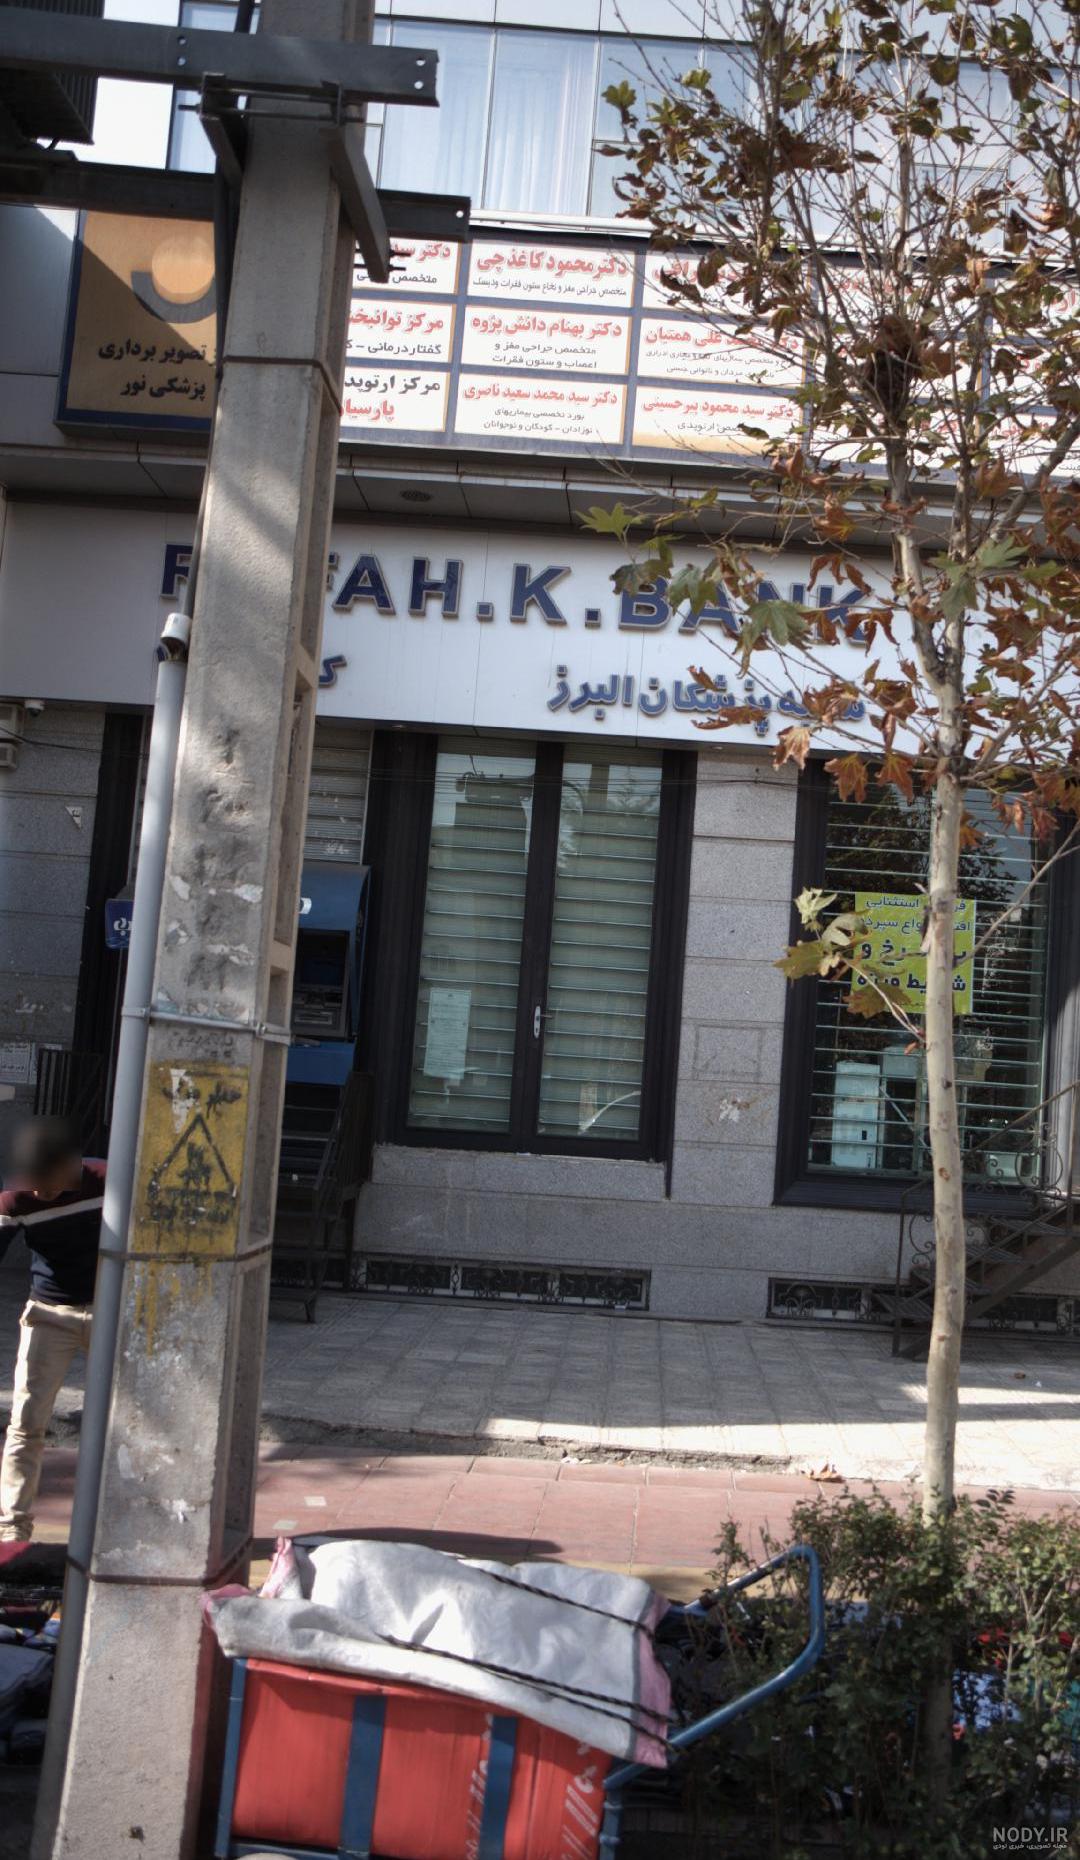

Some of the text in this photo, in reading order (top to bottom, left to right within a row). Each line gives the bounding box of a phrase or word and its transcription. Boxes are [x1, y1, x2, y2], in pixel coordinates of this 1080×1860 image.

[417, 242, 451, 262] دکتر
[546, 252, 593, 276] محمود
[593, 253, 628, 278] دکتر
[392, 273, 438, 285] متخصص
[405, 313, 444, 333] مرکز
[549, 319, 585, 338] بهنام
[588, 321, 623, 340] دکتر
[646, 326, 692, 345] همتیان
[98, 338, 157, 361] برداری
[158, 344, 207, 364] تصویر
[503, 341, 520, 351] مغز
[521, 342, 553, 354] جراحی
[555, 346, 597, 355] متخصص
[492, 355, 524, 365] فقرات
[525, 356, 554, 367] ستون
[564, 358, 598, 369] اعصاب
[120, 374, 206, 401] پزشکی نور
[345, 375, 441, 395] مرکز ارتوپد
[464, 383, 618, 407] دکتر سید محمد سعید ناصری
[339, 399, 395, 421] پارسیا
[702, 402, 739, 416] محمود
[743, 404, 765, 418] سید
[767, 404, 794, 421] دکتر
[548, 664, 634, 720] البرز
[864, 917, 898, 931] سپرد
